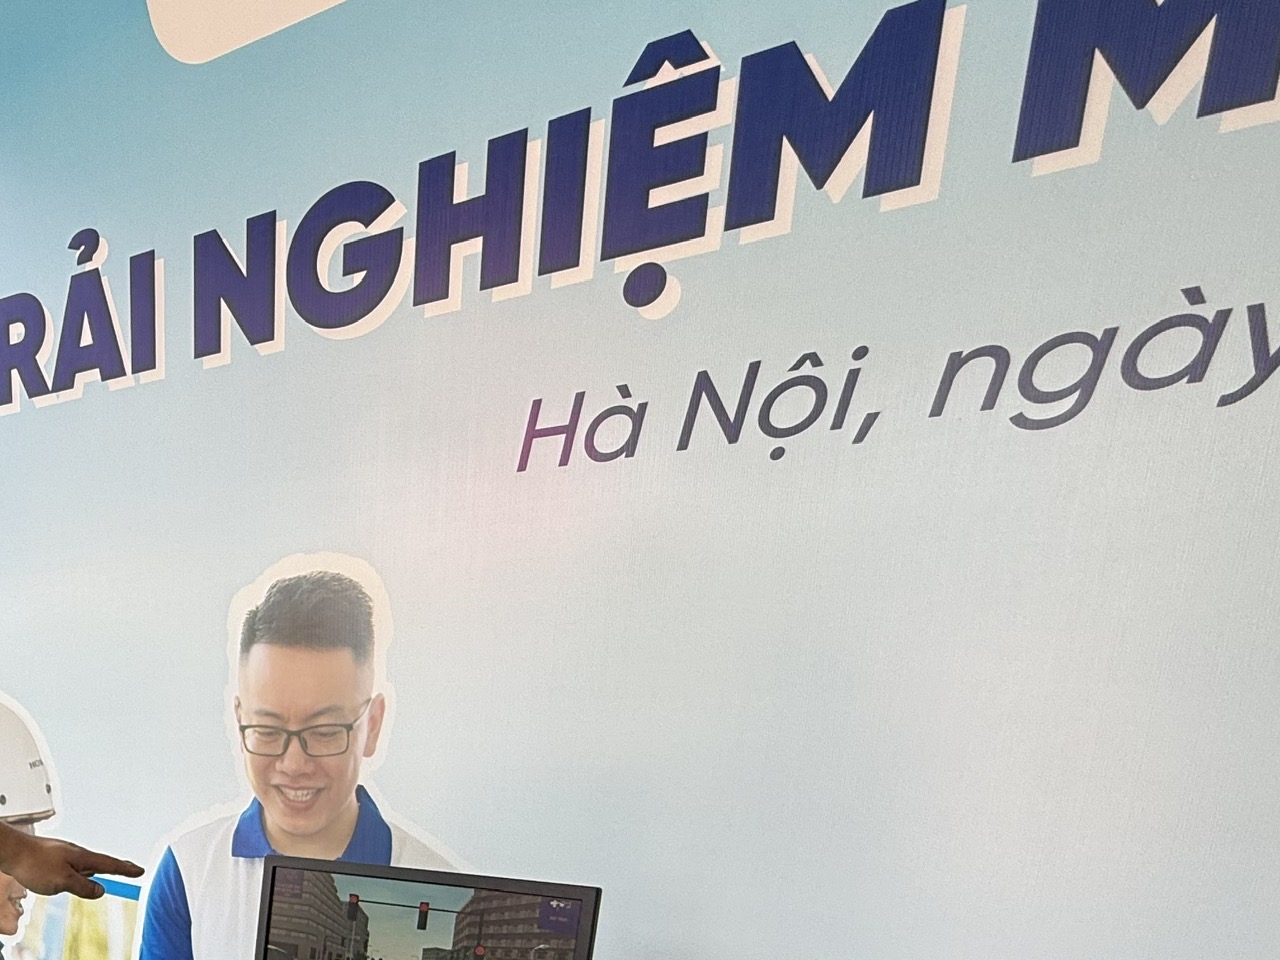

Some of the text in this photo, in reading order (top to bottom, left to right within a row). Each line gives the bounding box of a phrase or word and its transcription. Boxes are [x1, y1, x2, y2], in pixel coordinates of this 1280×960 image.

[193, 0, 948, 360] NGHIỆM
[516, 286, 1280, 473] Hà Nội, ngày
